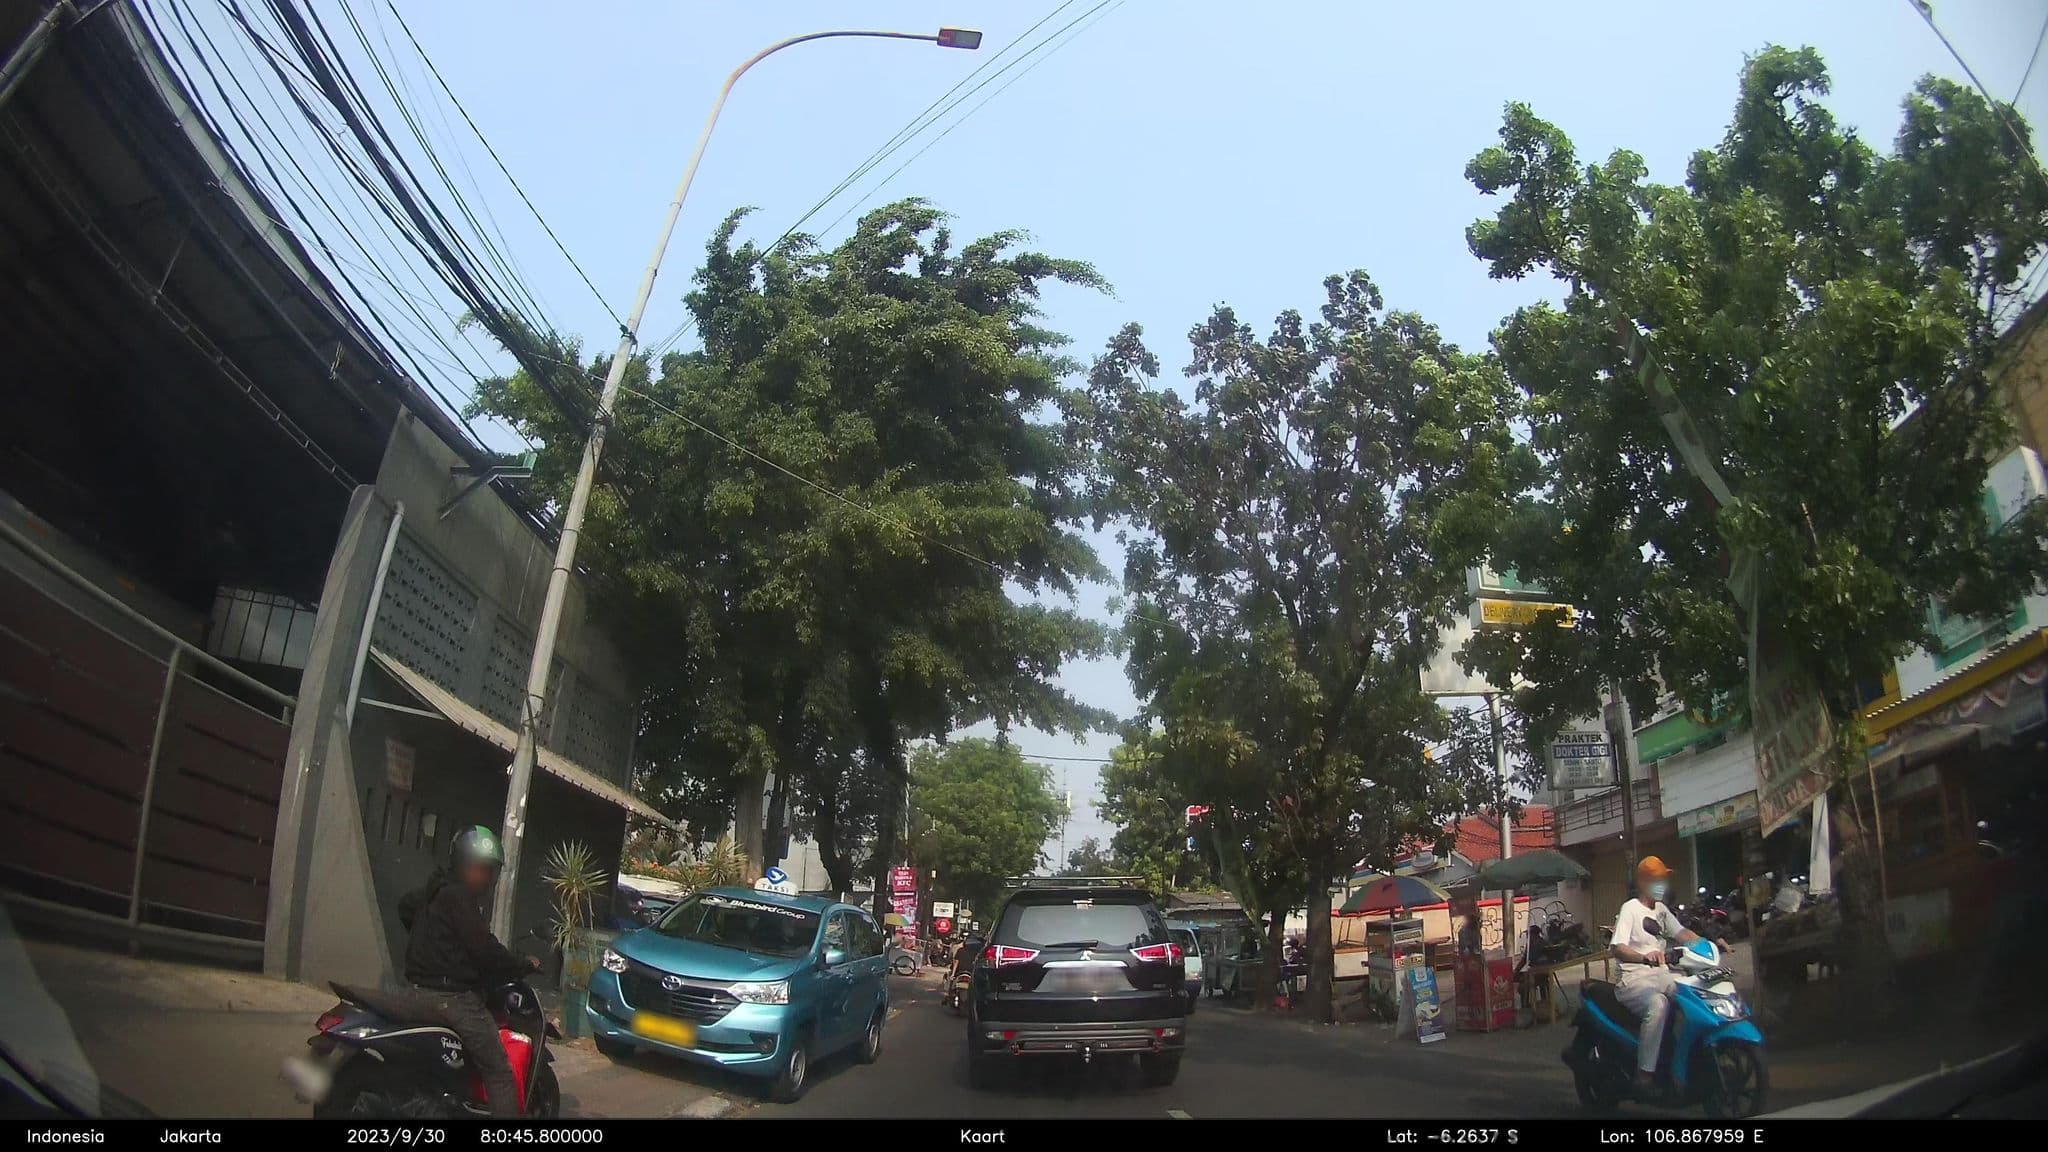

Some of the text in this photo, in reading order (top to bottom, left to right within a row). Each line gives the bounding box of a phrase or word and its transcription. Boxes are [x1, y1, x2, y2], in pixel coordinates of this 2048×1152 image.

[1558, 734, 1603, 743] PRAKTEK
[1555, 745, 1609, 757] DOKTER GIGI
[762, 883, 789, 893] TAKSI
[729, 900, 805, 919] Bluebird Group
